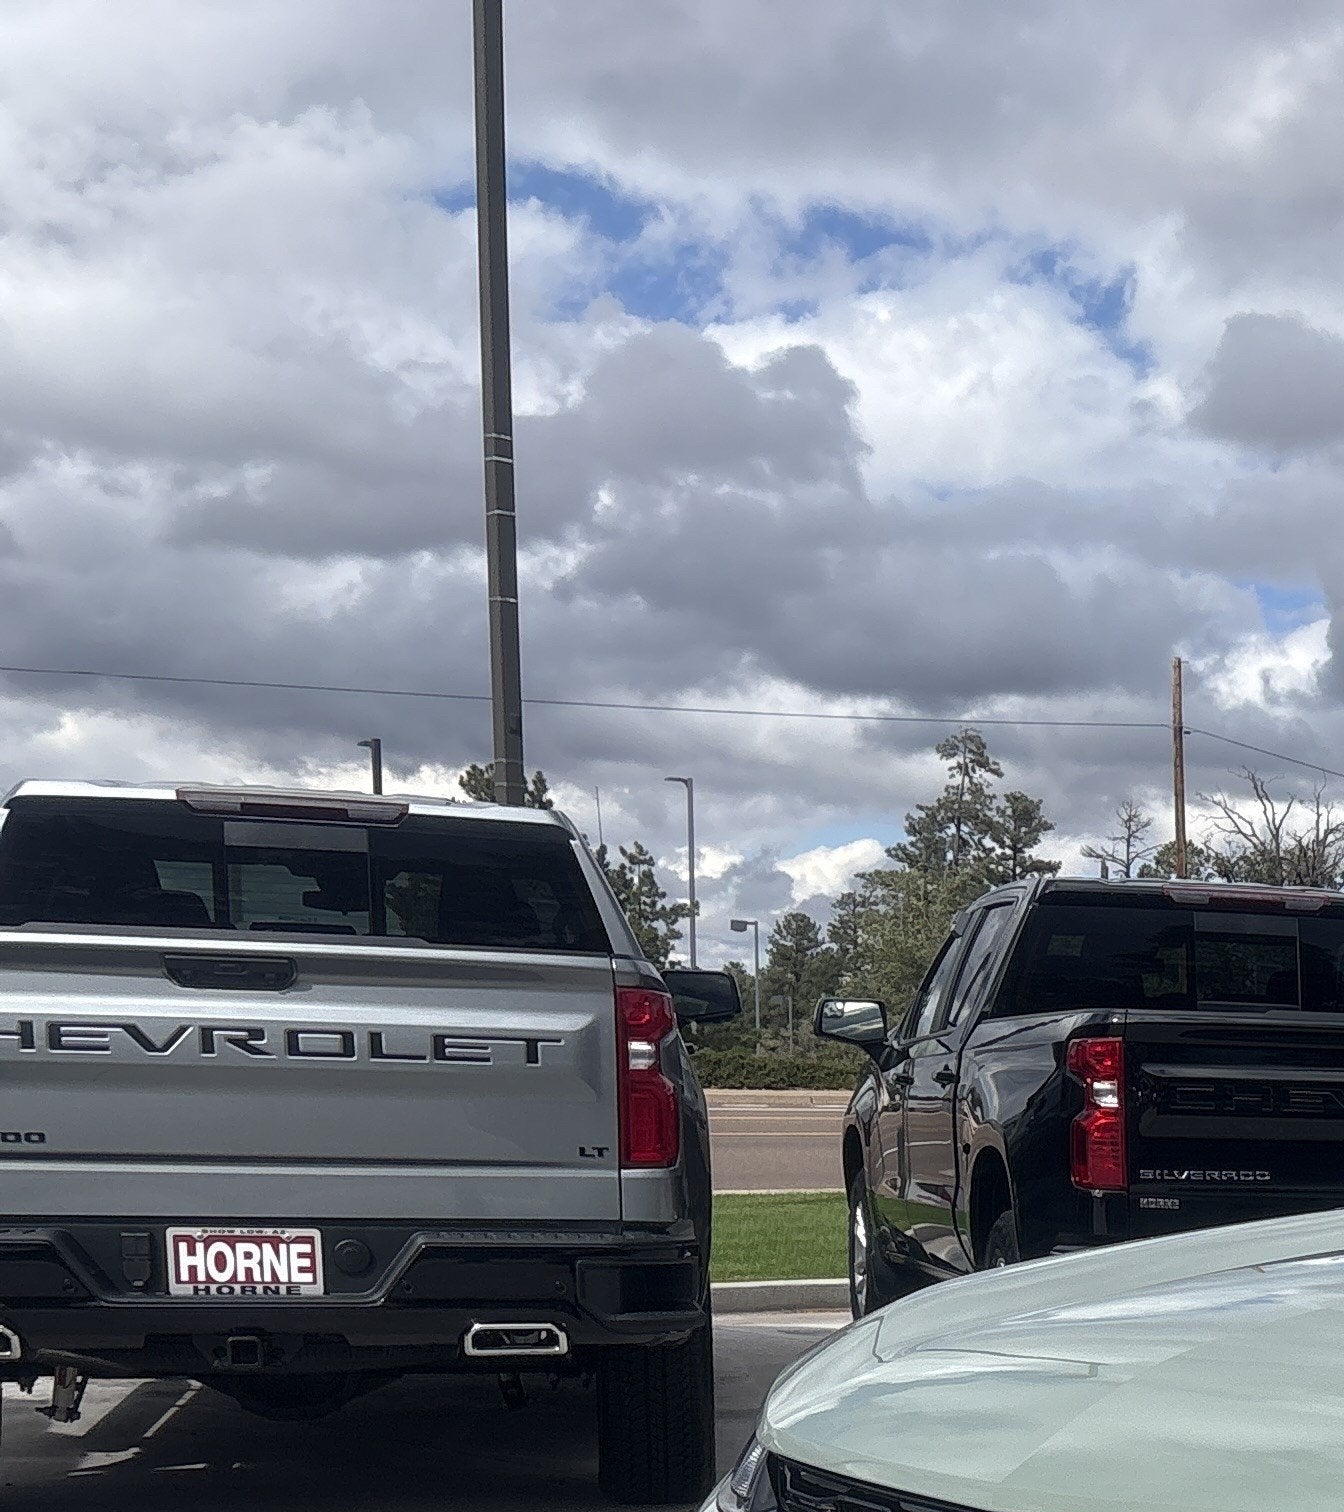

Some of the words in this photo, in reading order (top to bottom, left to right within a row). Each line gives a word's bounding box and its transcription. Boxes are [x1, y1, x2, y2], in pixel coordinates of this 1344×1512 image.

[0, 1019, 566, 1067] HEVROLET
[578, 1146, 610, 1158] LT
[1139, 1169, 1271, 1181] SILVERADO
[178, 1240, 314, 1283] HORNE
[192, 1285, 303, 1296] HORNE
